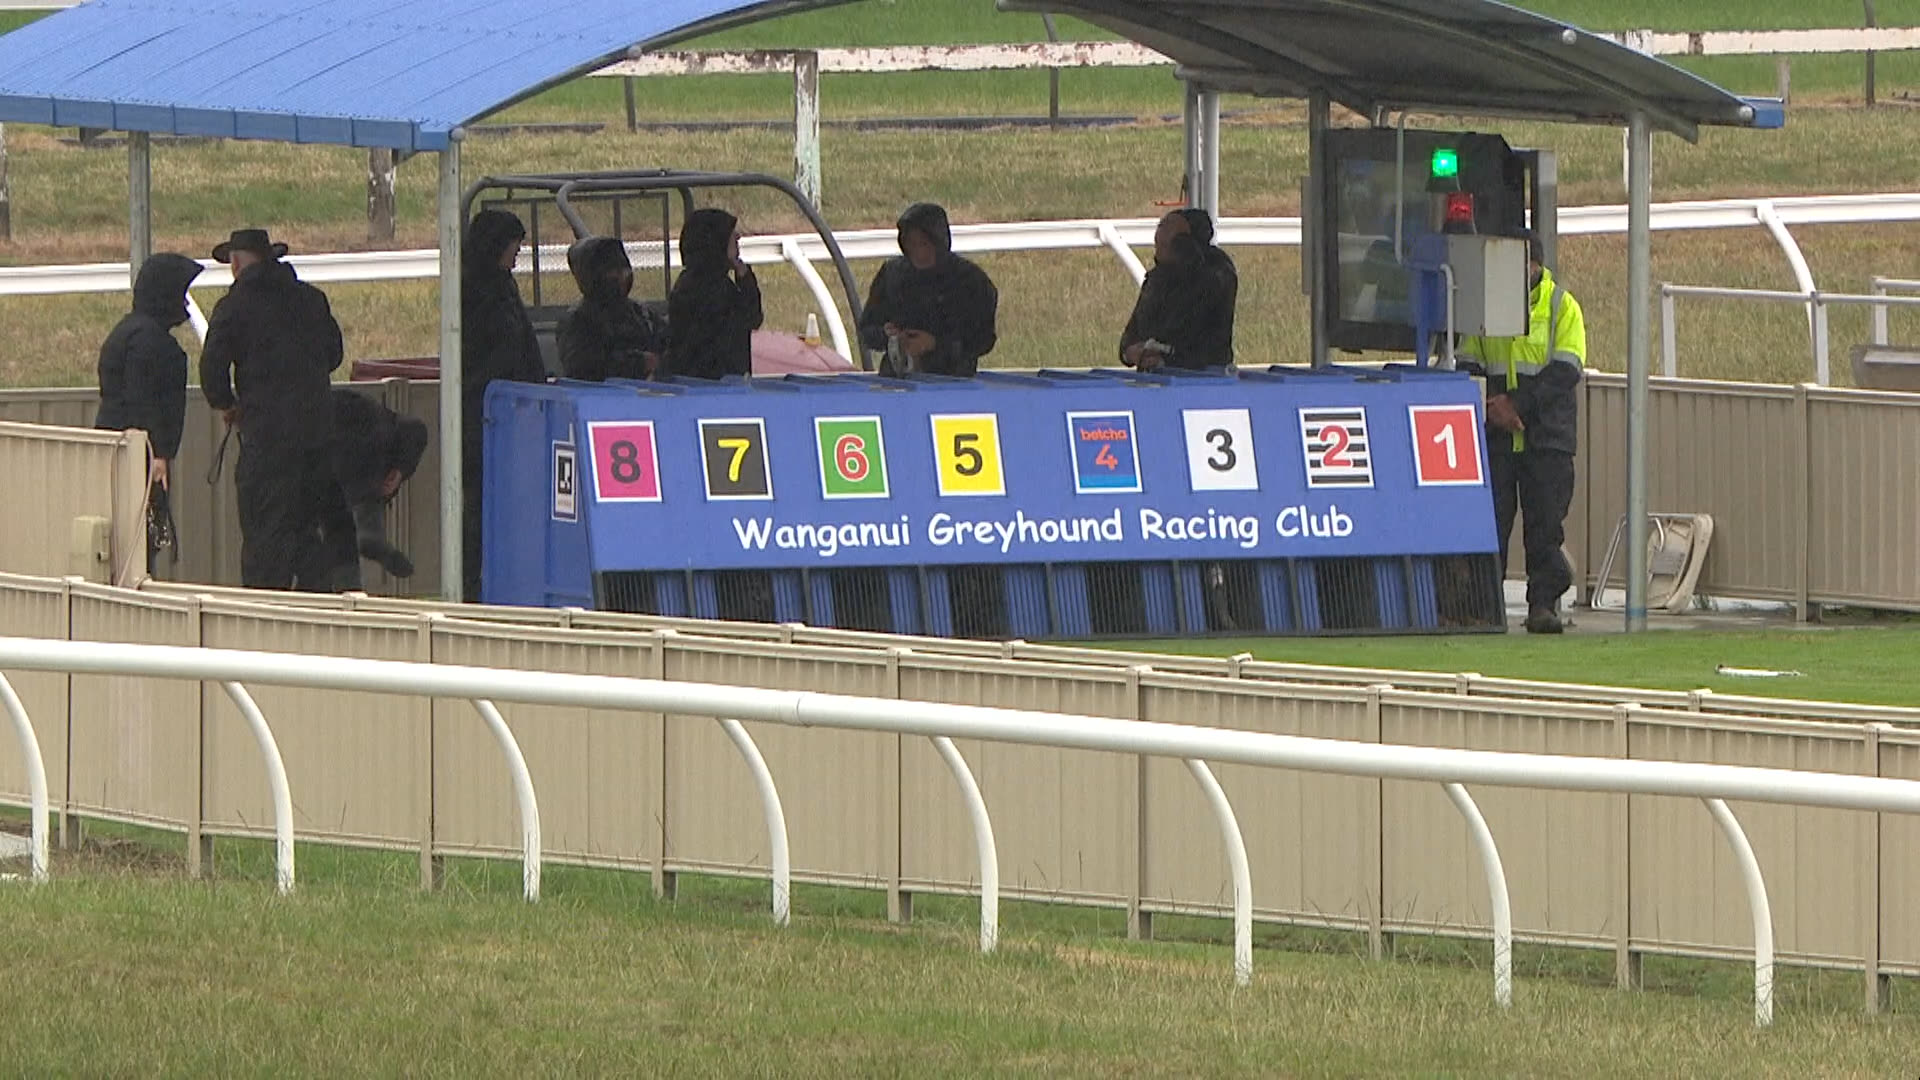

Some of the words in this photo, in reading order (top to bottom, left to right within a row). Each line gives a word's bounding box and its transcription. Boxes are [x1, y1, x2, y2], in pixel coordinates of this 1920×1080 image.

[954, 432, 983, 476] 5
[1080, 427, 1128, 440] betcha
[1206, 428, 1236, 472] 3
[1318, 424, 1353, 467] 2
[1433, 423, 1458, 470] 1
[611, 440, 641, 483] 8
[717, 438, 750, 482] 7
[834, 433, 868, 481] 6
[1095, 444, 1118, 471] 4
[732, 514, 910, 557] Wanganui
[928, 508, 1124, 554] Greyhound
[1139, 508, 1260, 549] Racing
[1275, 504, 1355, 539] Club
